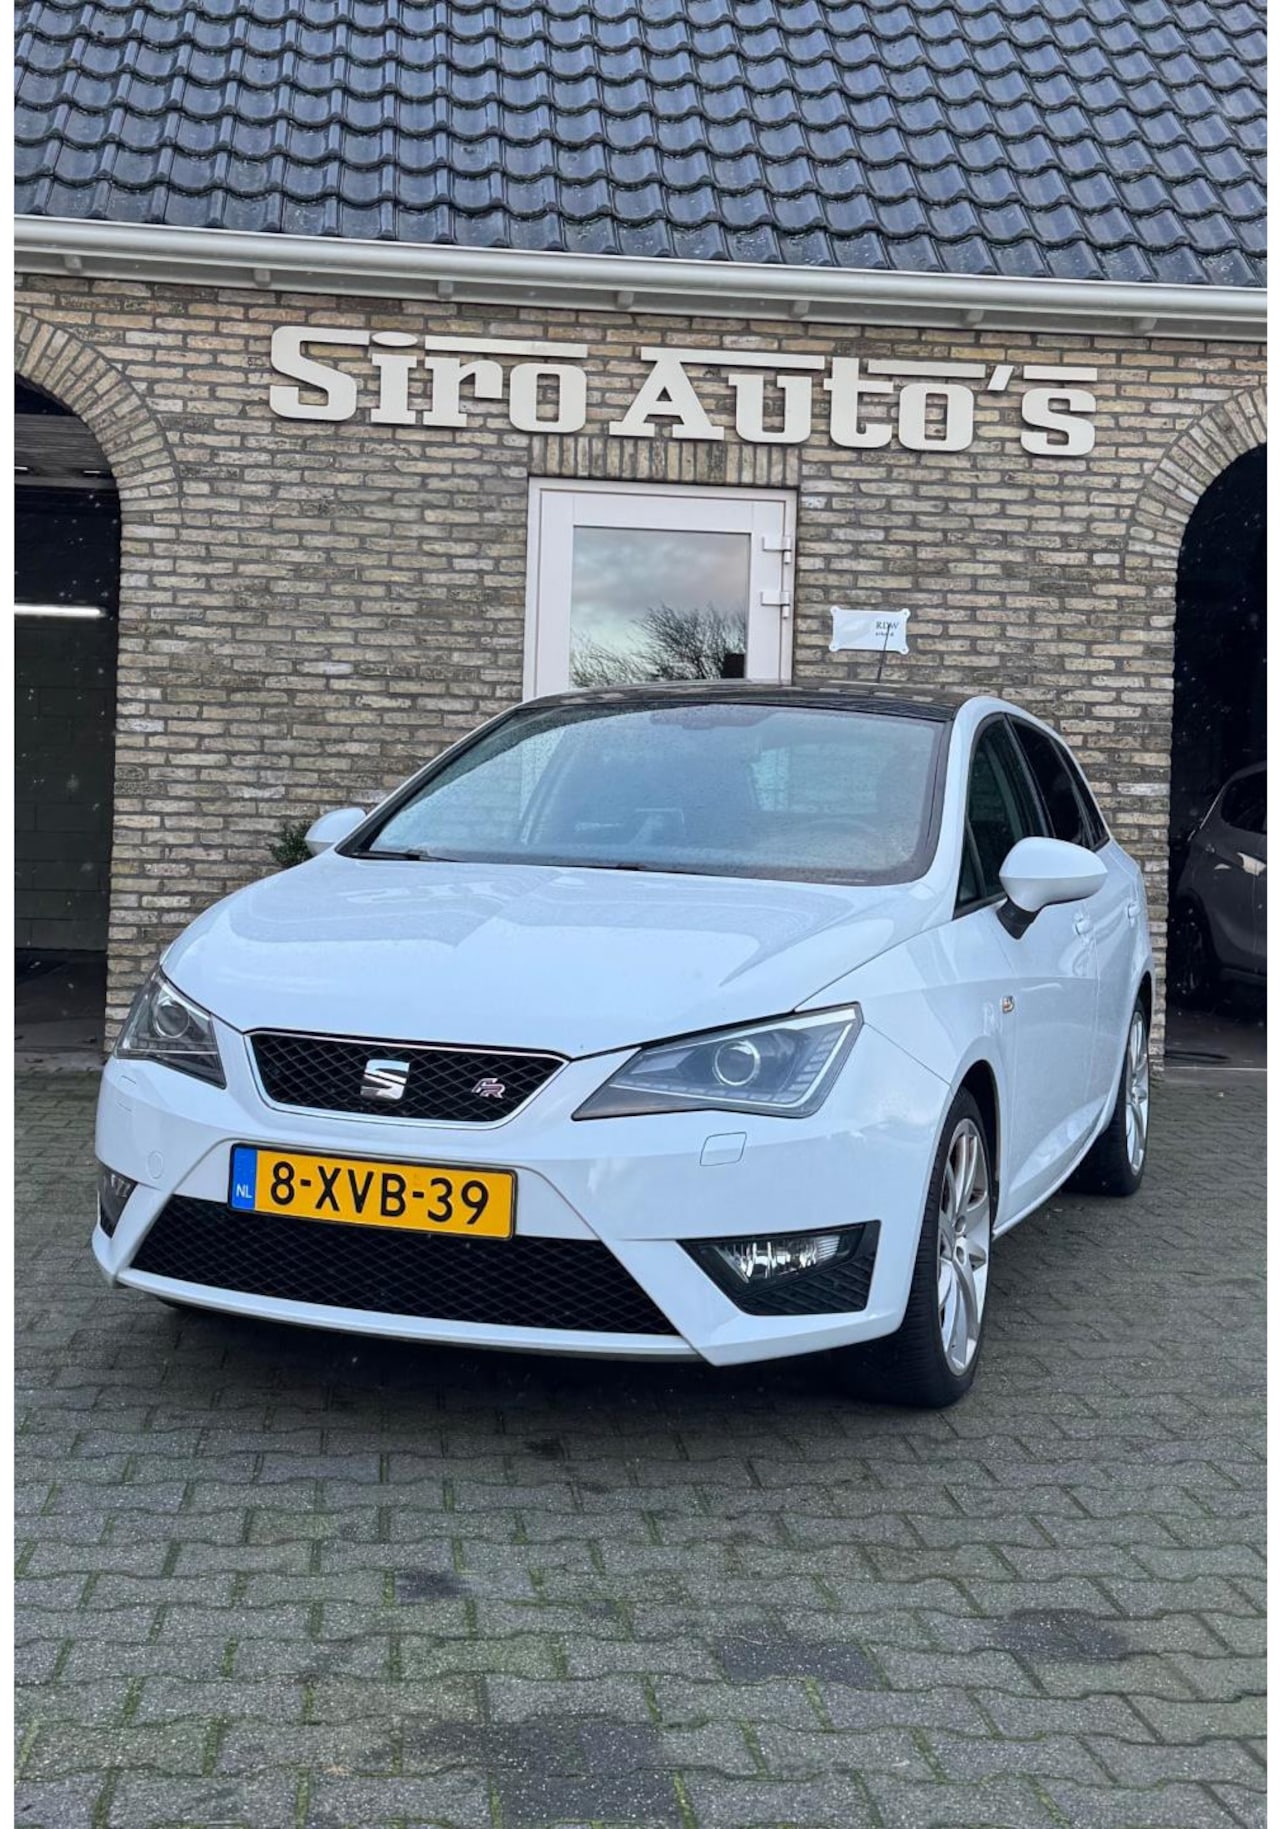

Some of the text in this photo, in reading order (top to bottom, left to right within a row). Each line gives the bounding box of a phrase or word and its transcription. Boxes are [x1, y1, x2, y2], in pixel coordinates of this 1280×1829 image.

[269, 325, 1098, 456] Siro Auto's
[235, 1161, 489, 1225] NL 8-XVB-39
